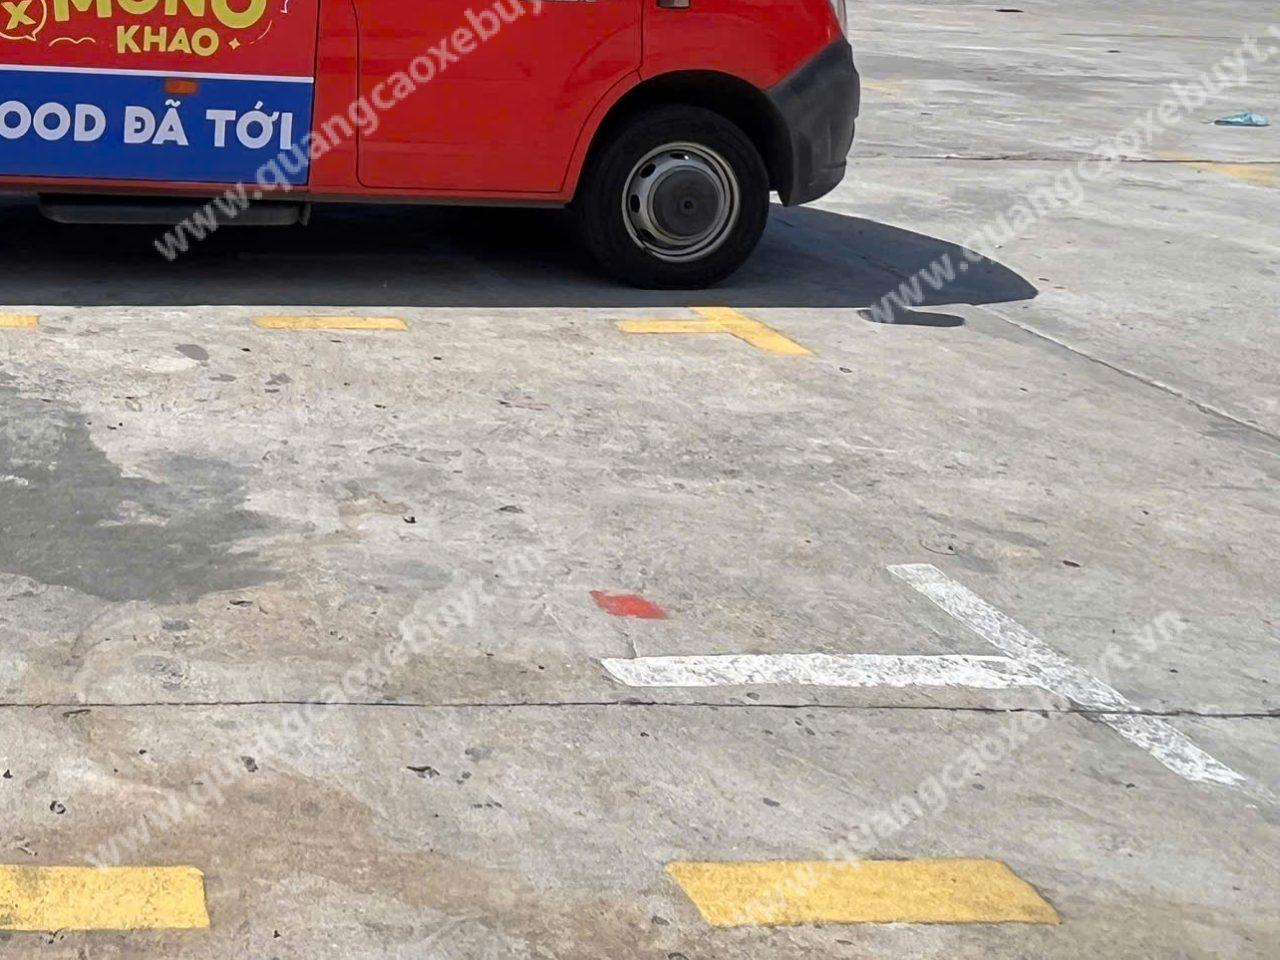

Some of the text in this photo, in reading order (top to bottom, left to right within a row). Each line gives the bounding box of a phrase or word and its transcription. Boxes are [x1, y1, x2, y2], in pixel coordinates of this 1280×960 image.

[116, 25, 219, 56] KHAO
[124, 99, 189, 146] ĐÃ
[206, 100, 293, 150] TỚI
